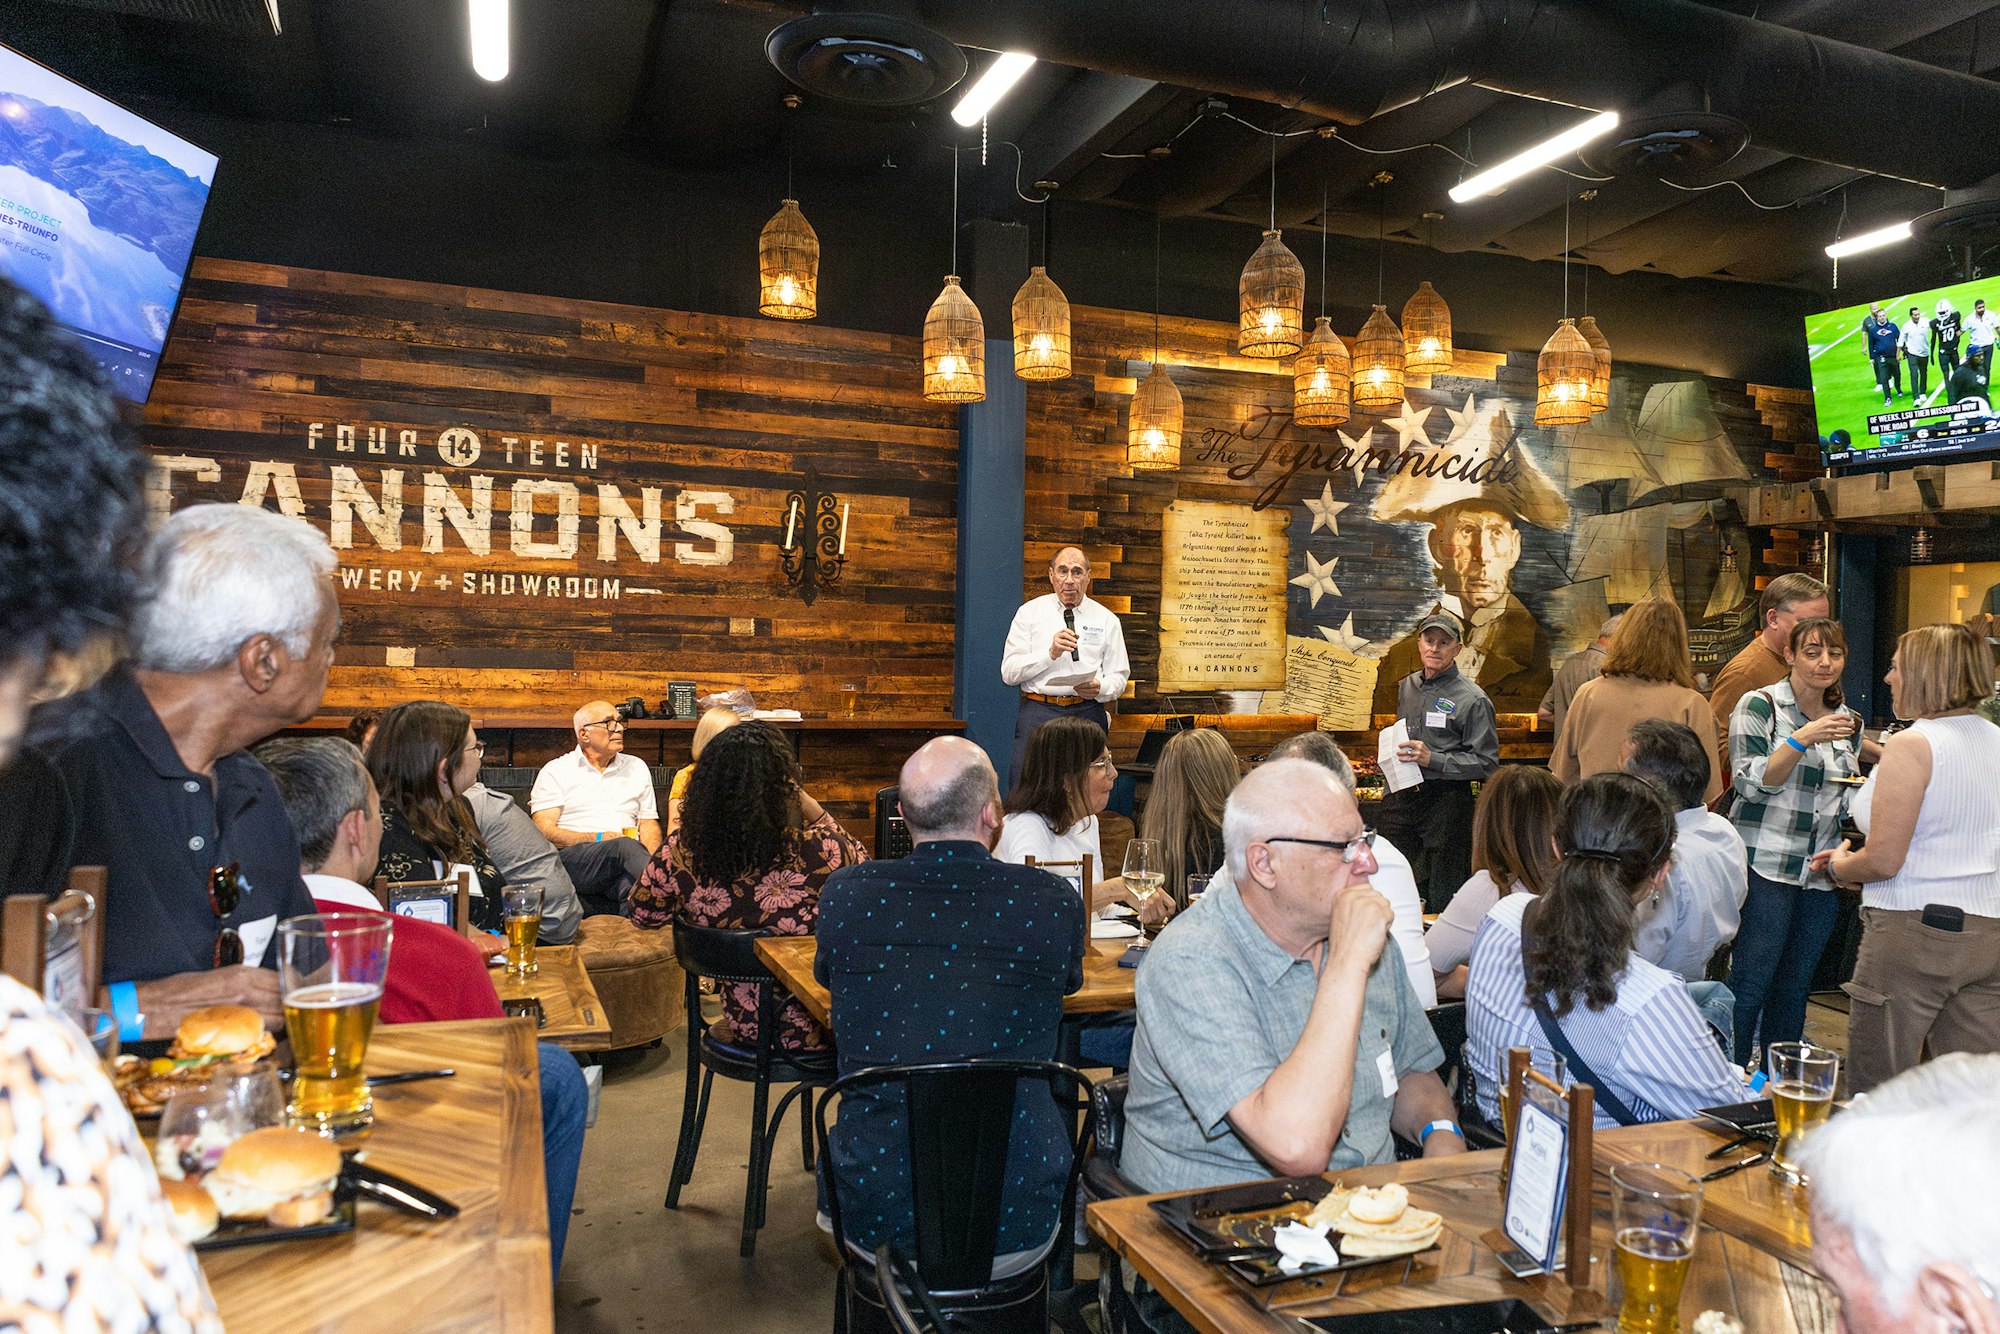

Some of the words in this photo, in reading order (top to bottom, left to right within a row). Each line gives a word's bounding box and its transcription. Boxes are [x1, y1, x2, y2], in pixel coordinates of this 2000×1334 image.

[0, 198, 15, 210] ER
[18, 205, 62, 228] PROJECT
[15, 242, 30, 254] Full
[30, 248, 52, 262] Circle
[1942, 328, 1954, 342] 10
[1901, 412, 1914, 420] LSU
[1914, 409, 1930, 418] THEN
[1930, 405, 1960, 416] MISSOURI
[1880, 424, 1891, 432] THE
[1892, 422, 1908, 430] ROAD
[1917, 429, 1929, 438] 6
[1984, 420, 2000, 430] 2
[308, 423, 417, 458] FOUR
[502, 437, 598, 470] TEEN
[1196, 427, 1242, 465] The
[1227, 404, 1523, 511] Tyrannicide
[328, 567, 422, 593] WERY
[462, 572, 620, 600] SHOWROOM
[1215, 581, 1256, 589] Revolutionary
[1186, 592, 1208, 600] fought
[1194, 604, 1218, 612] through
